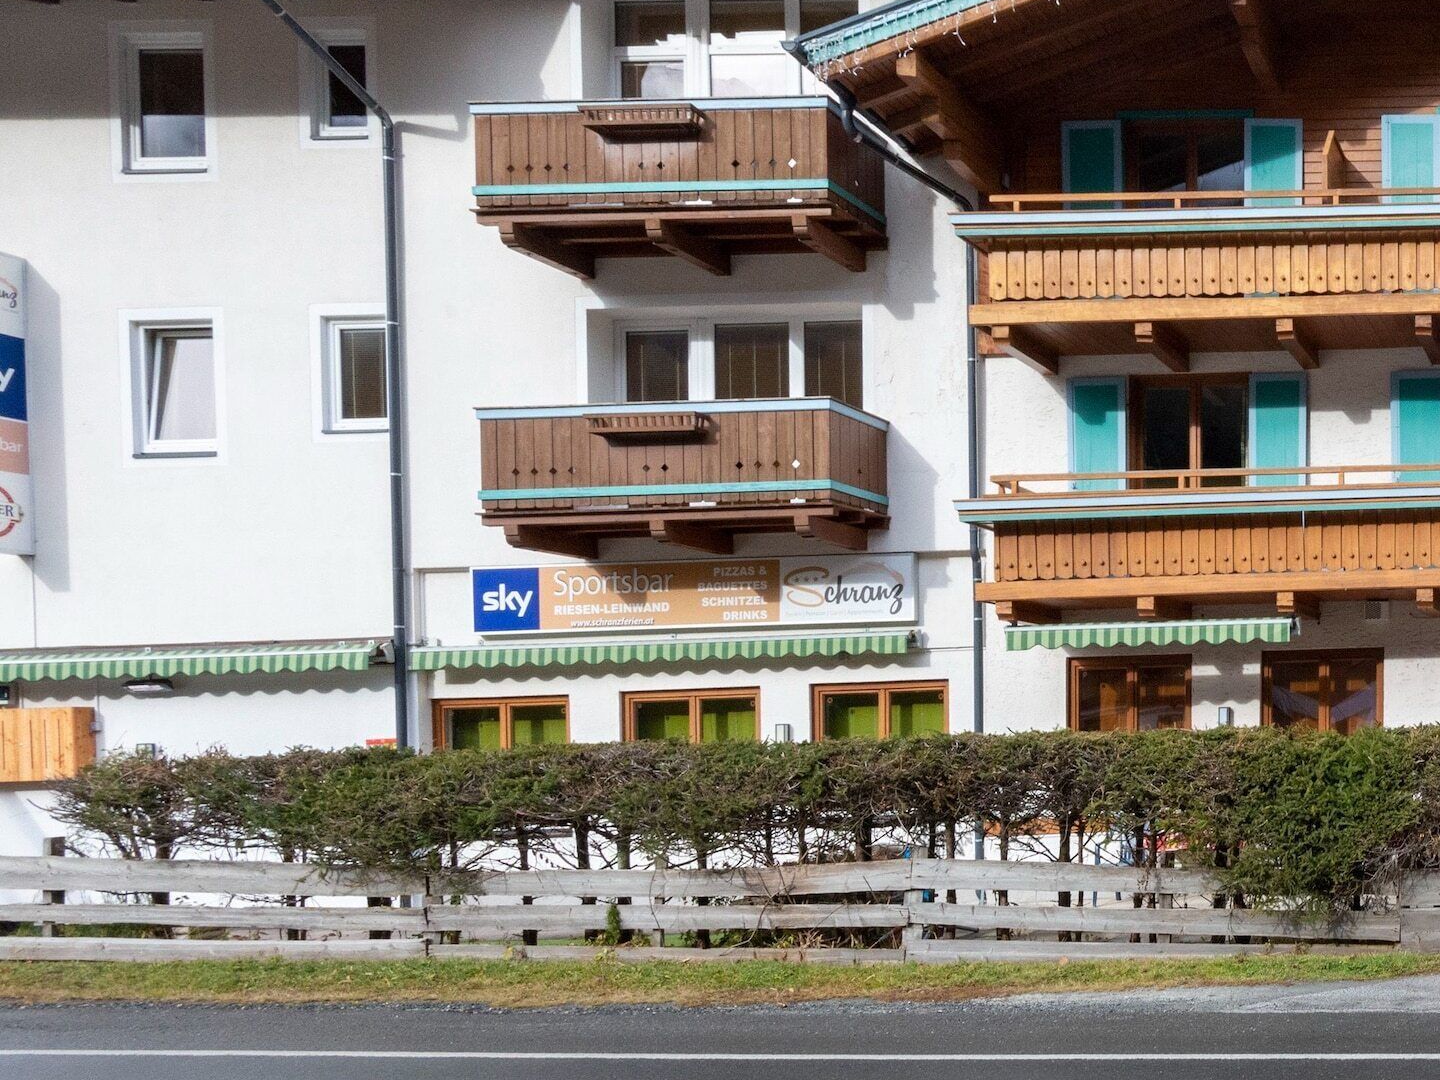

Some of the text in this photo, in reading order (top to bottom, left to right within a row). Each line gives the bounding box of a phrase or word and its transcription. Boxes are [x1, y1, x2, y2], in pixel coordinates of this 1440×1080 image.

[713, 566, 767, 577] PIZZAS &
[553, 568, 674, 602] Sportsbar
[697, 581, 767, 592] BAGUETTES
[784, 566, 904, 614] Schranz
[482, 583, 533, 617] sky
[702, 595, 768, 607] SCHNITZEL
[554, 602, 670, 615] RIESEN-LEINWAND
[723, 610, 768, 620] DRINKS
